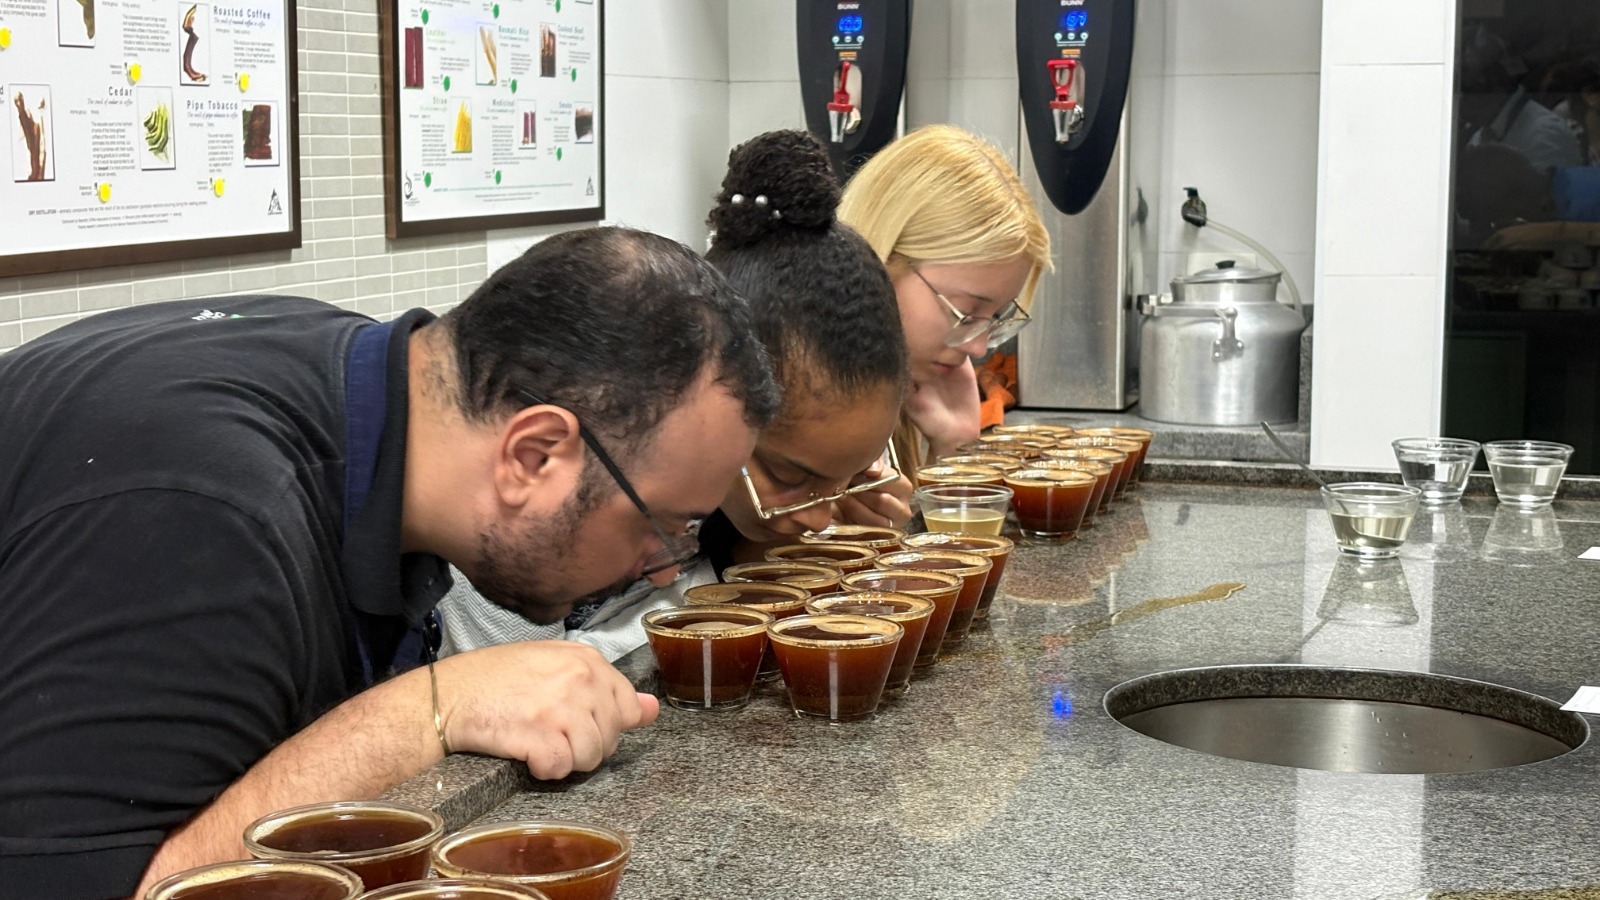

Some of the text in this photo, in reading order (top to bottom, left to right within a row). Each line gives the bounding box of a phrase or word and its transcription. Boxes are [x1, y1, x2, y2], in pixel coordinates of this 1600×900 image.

[213, 6, 271, 20] Roasted Coffee
[108, 86, 133, 97] Cedar
[186, 100, 239, 111] Pipe Tobacco
